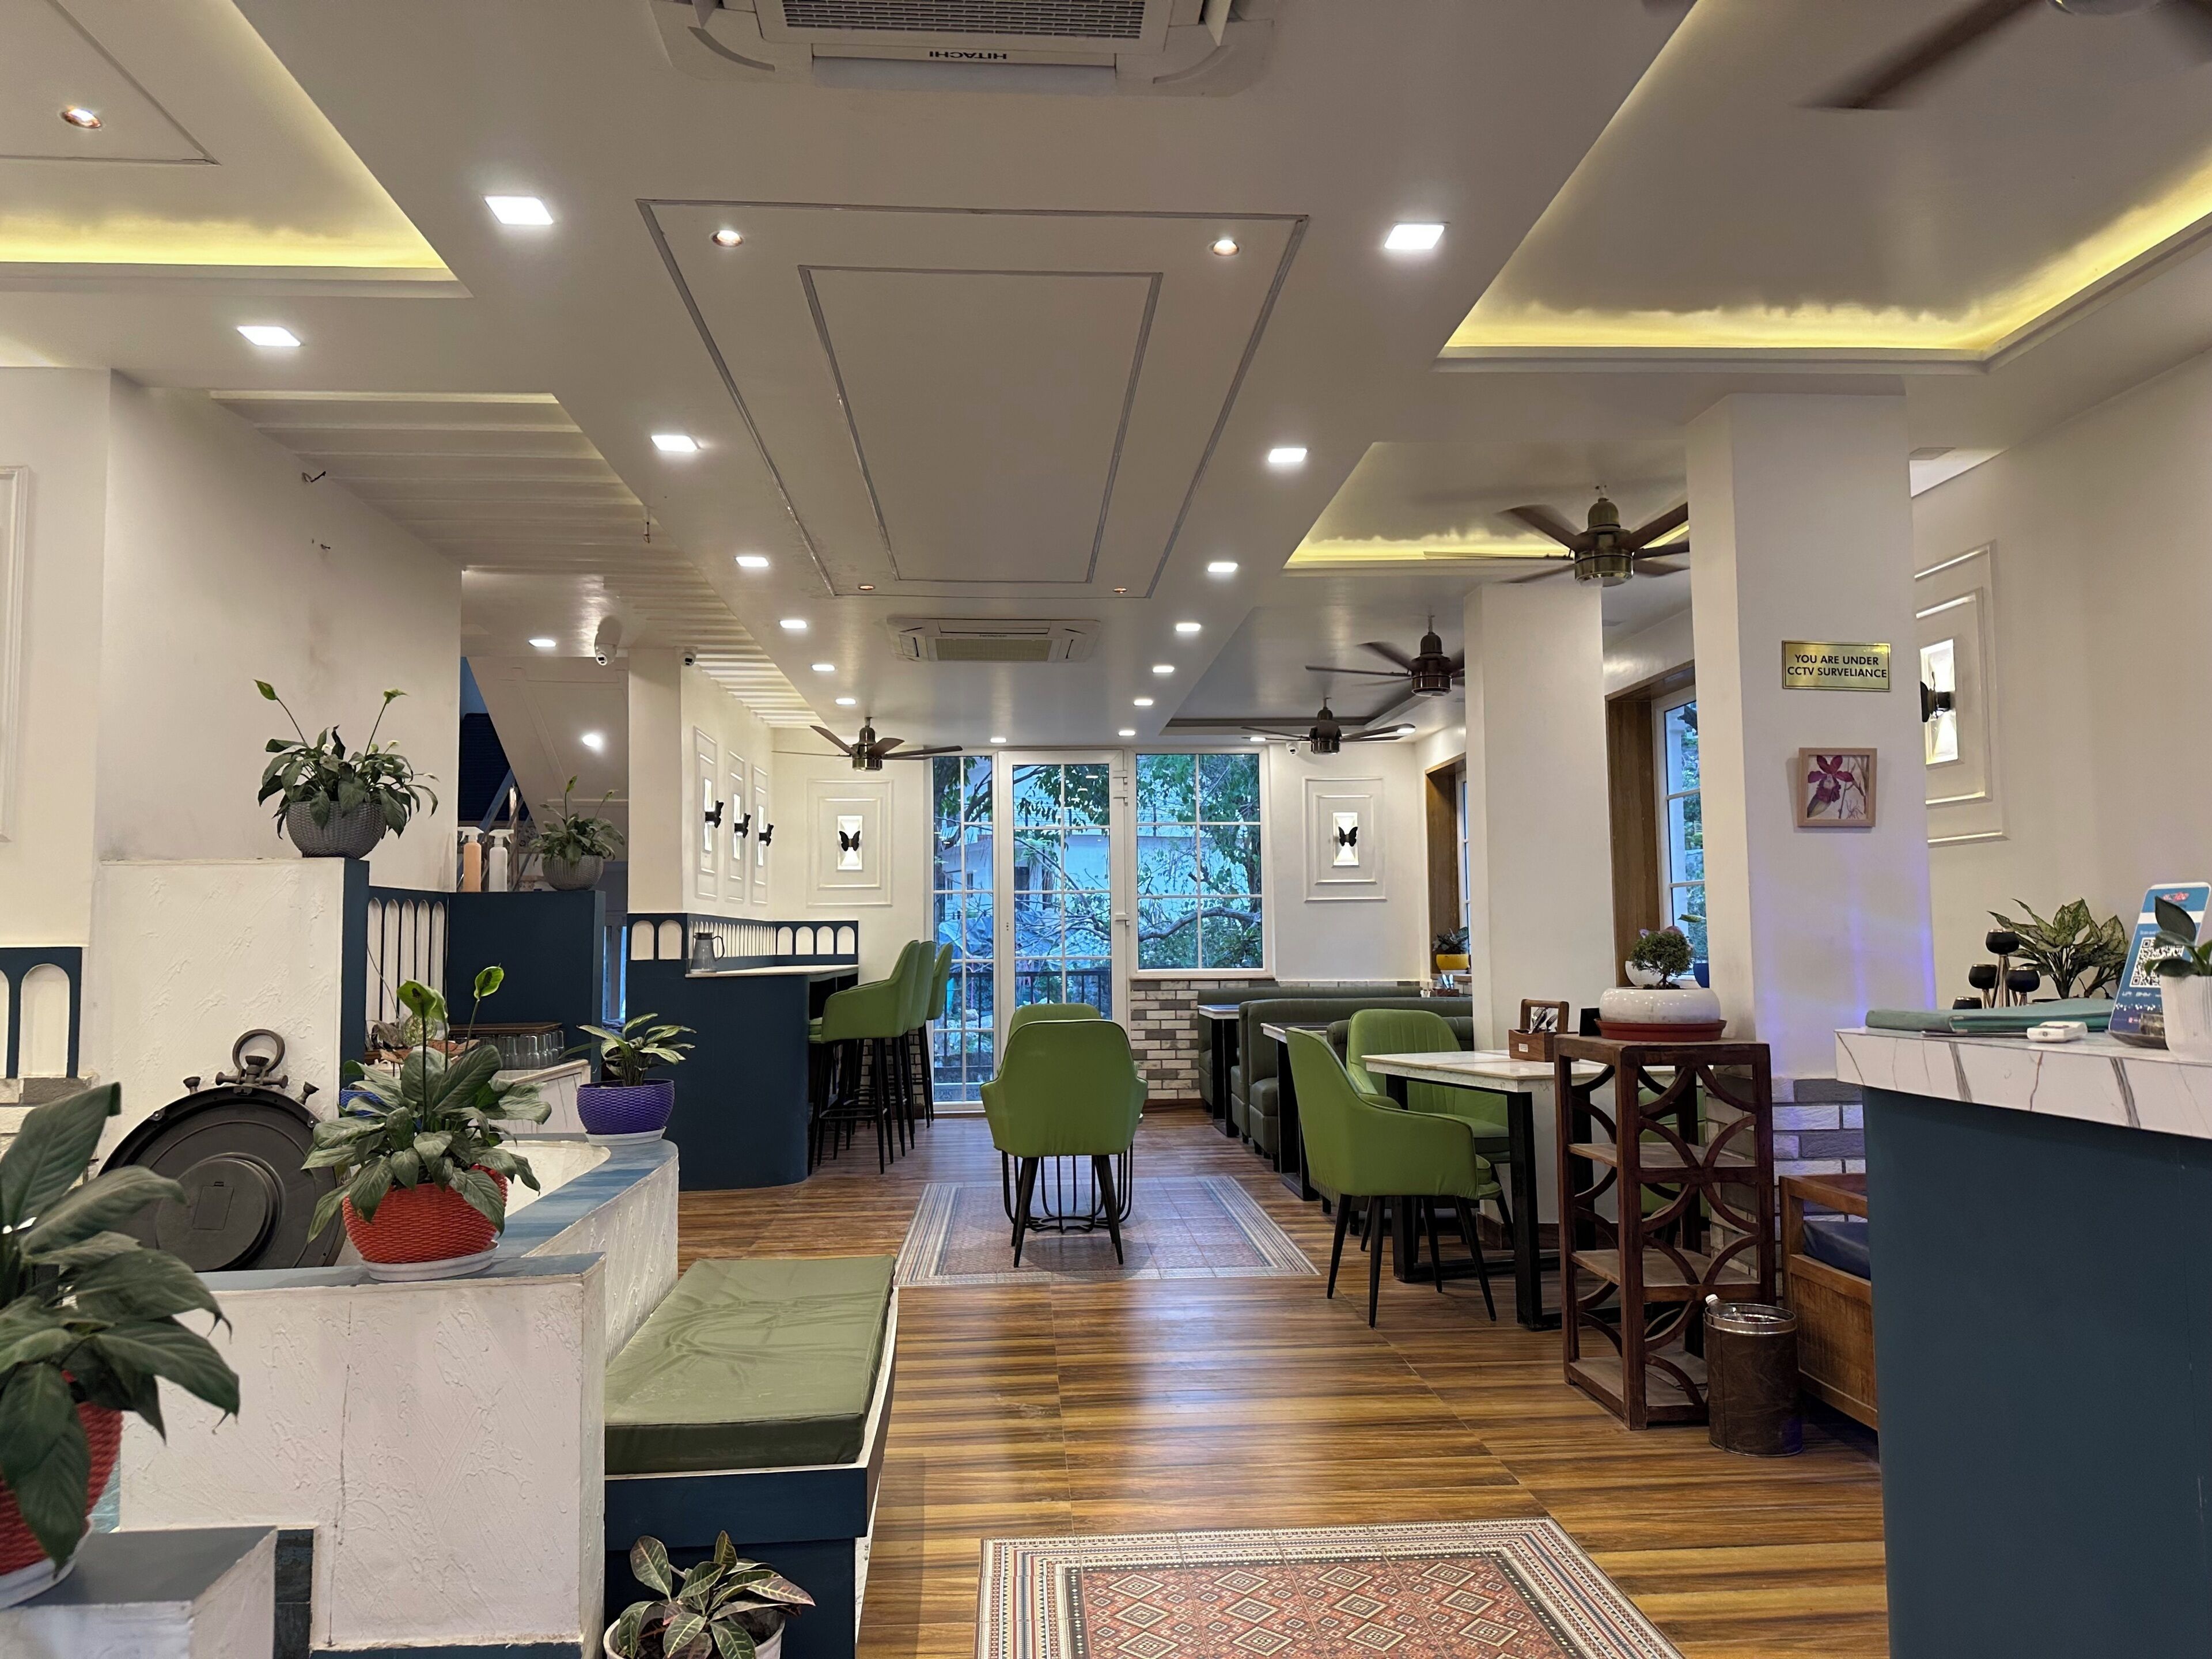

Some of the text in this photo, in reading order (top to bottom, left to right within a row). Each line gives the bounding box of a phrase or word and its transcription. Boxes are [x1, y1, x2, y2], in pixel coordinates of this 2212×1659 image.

[929, 51, 1006, 59] HITACHI
[1795, 654, 1879, 665] YOU ARE UNDER
[1787, 666, 1887, 678] CCTV SURVELIANCE
